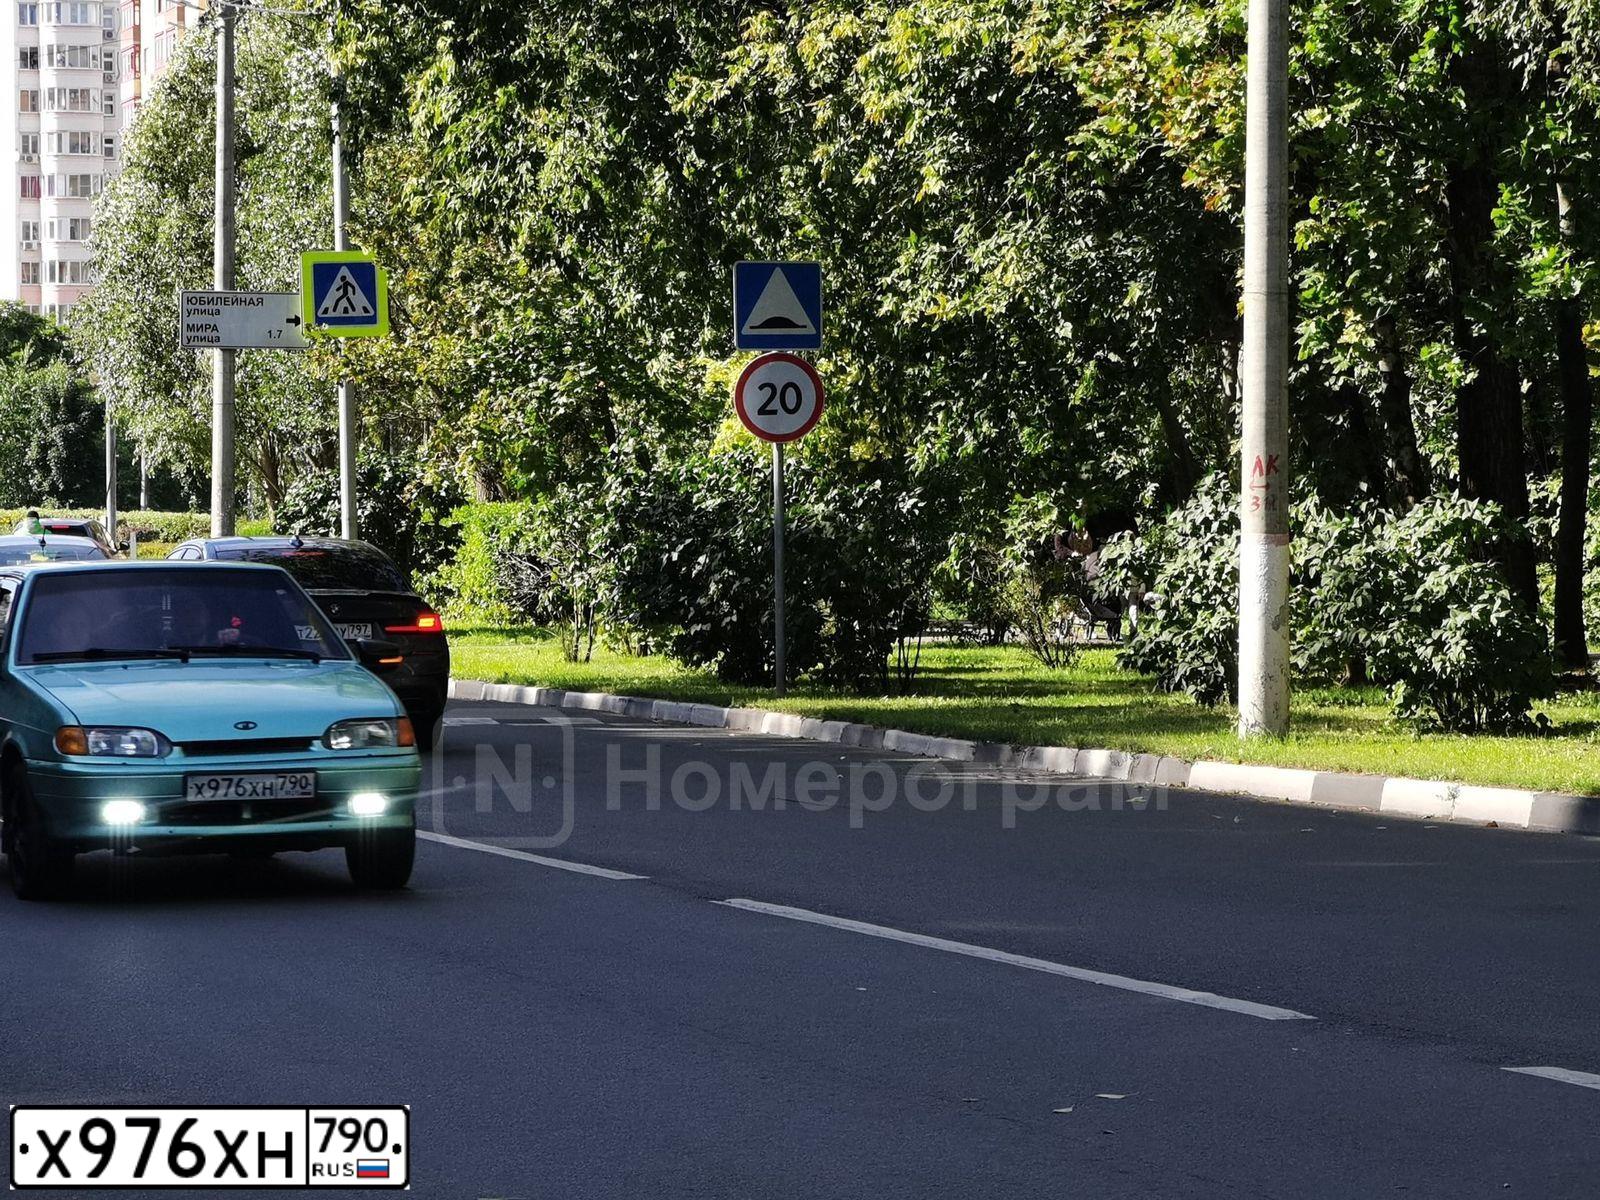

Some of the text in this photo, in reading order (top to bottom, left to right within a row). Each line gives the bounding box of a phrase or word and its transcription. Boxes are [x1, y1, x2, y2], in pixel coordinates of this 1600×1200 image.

[186, 296, 264, 307] ЮБИЛЕЙНАЯ
[186, 308, 221, 317] улица
[186, 323, 219, 333] МИРА
[186, 334, 221, 344] улица
[267, 329, 283, 339] 1.7
[757, 381, 803, 416] 20
[349, 624, 369, 635] 797
[277, 774, 309, 791] 790
